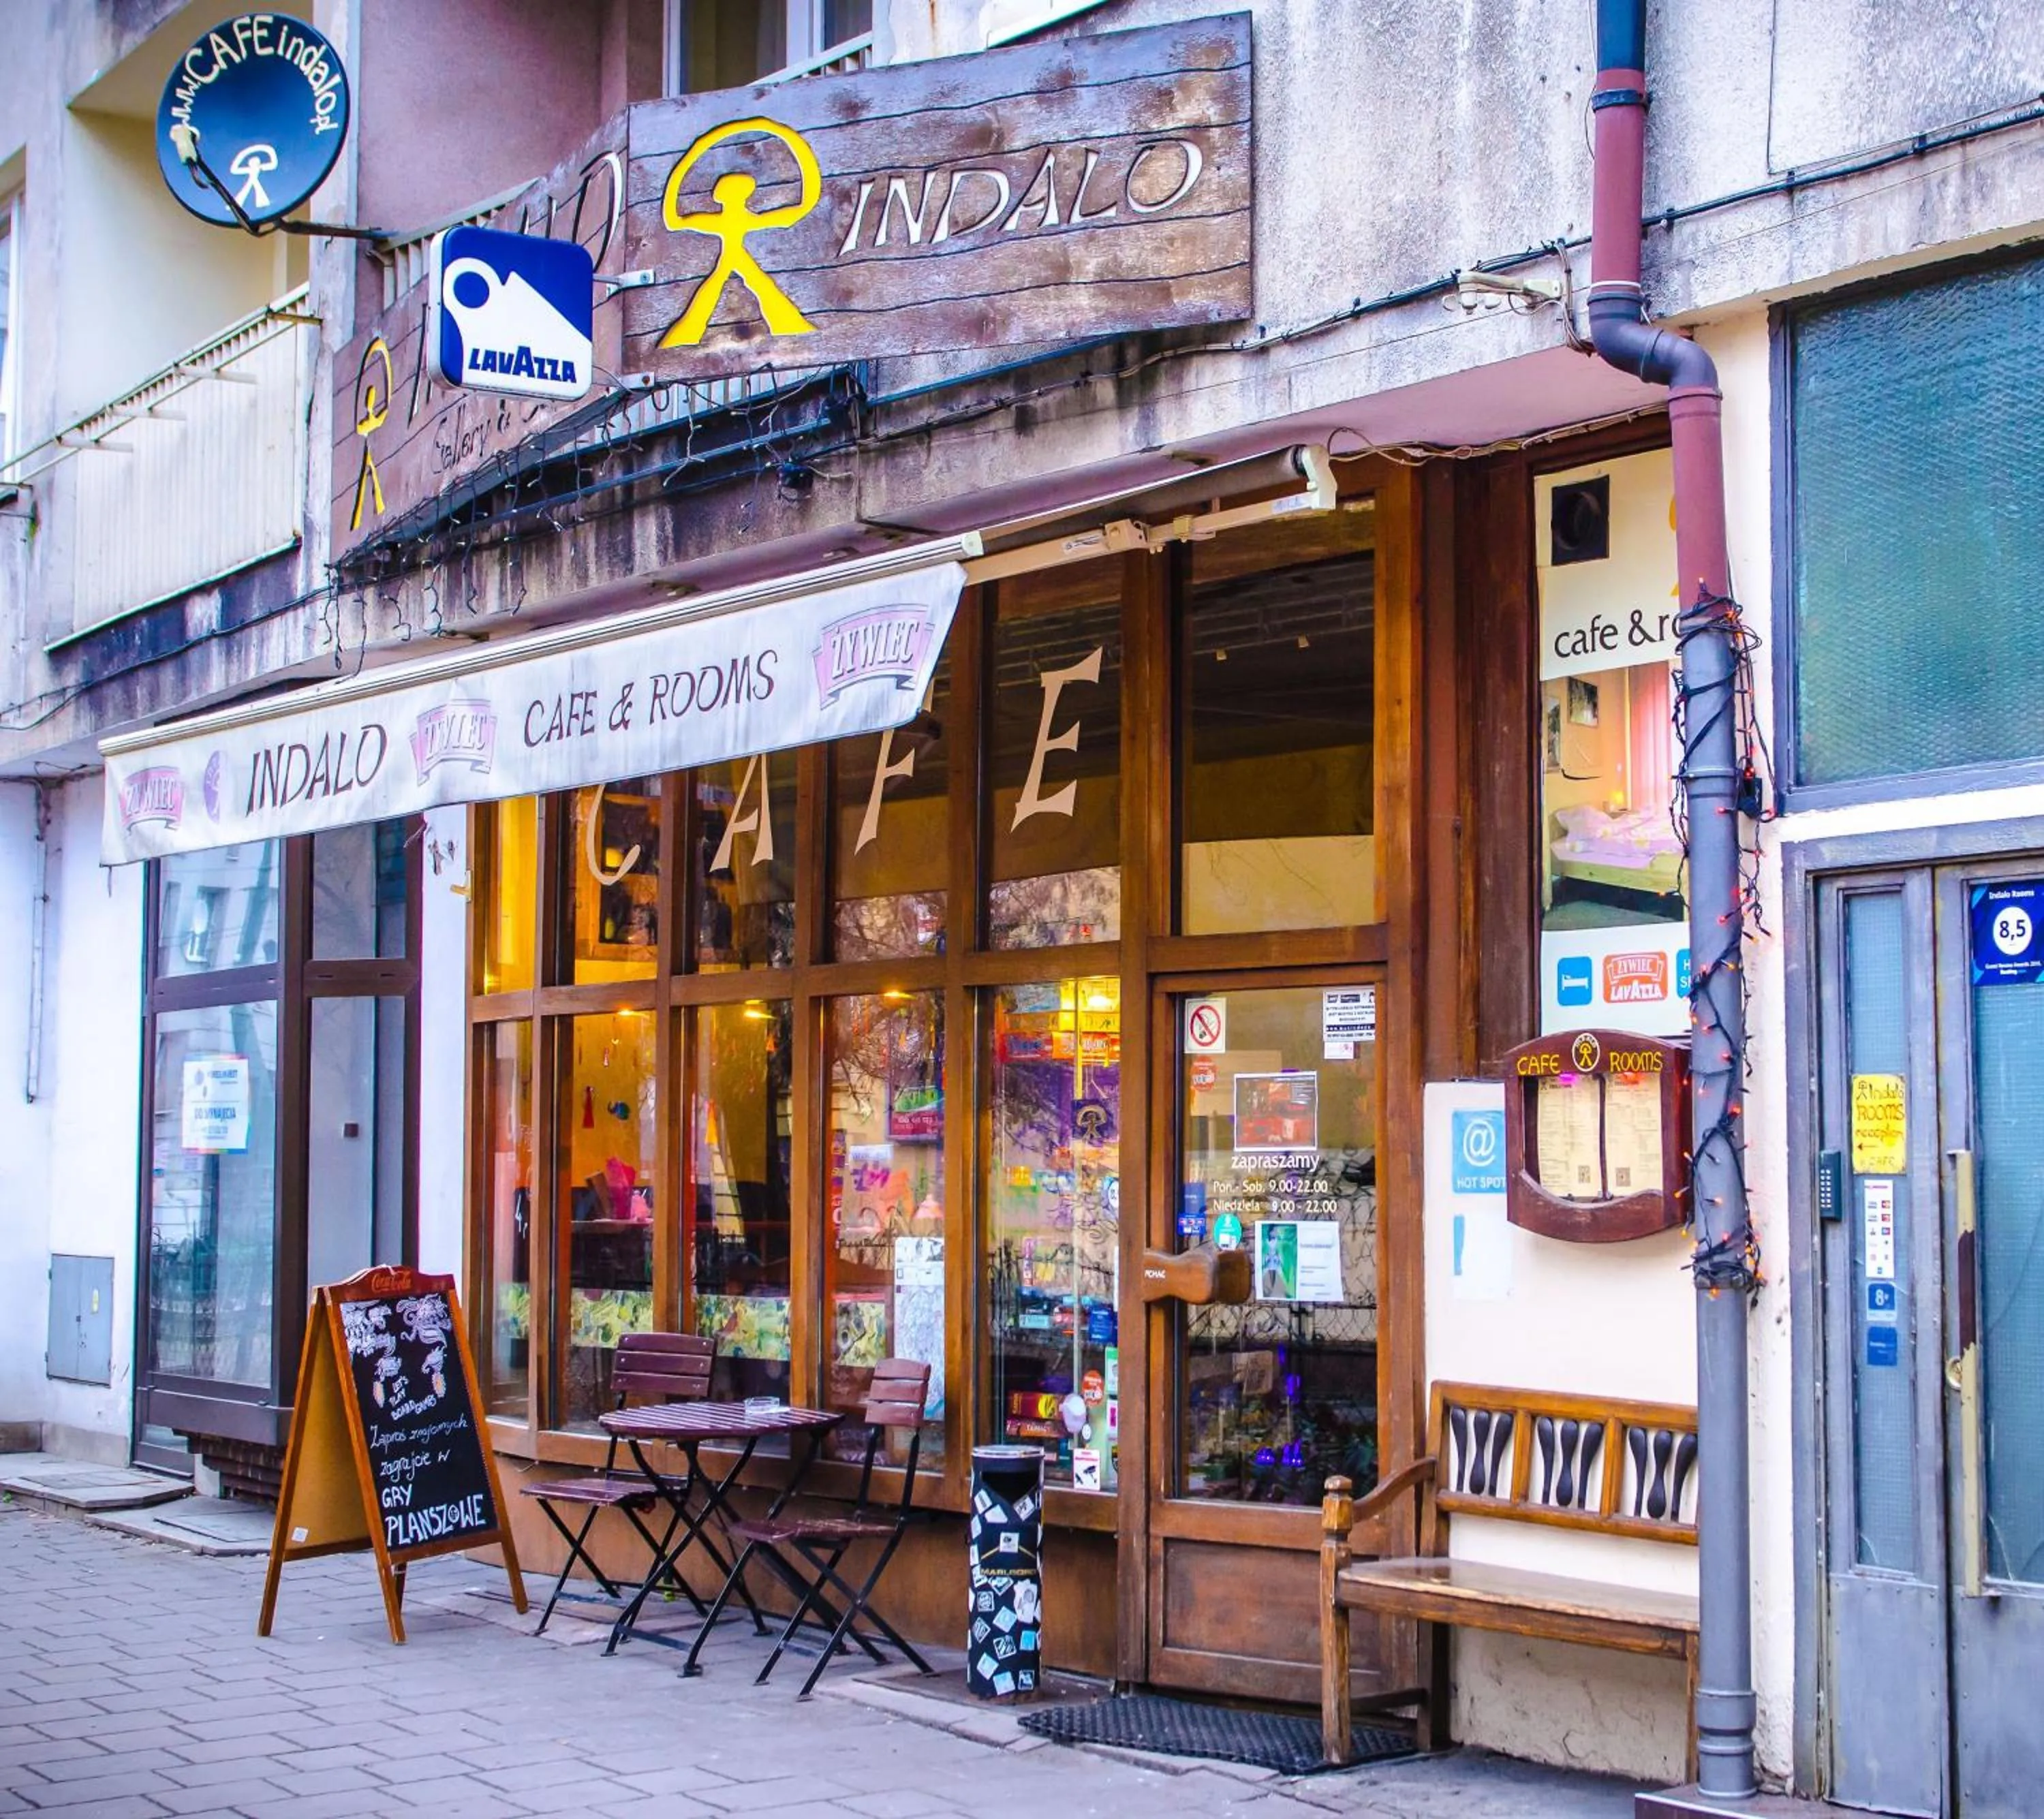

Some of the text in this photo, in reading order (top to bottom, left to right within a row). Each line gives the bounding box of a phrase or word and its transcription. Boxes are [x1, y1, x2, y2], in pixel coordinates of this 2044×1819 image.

[837, 139, 1203, 257] INDALO
[468, 345, 577, 384] LAVAZZA
[431, 403, 491, 474] Gallery
[1554, 615, 1618, 658] cafe
[1628, 609, 1657, 646] &
[523, 649, 778, 747] CAFE & ROOMS
[245, 724, 388, 818] INDALO
[586, 646, 1103, 886] CAFE
[1999, 920, 2026, 940] 8,5
[1611, 980, 1663, 1000] LAVAZZA
[1517, 1051, 1663, 1075] CAFE ROOMS
[1857, 1104, 1904, 1121] ROOMS
[1231, 1154, 1320, 1172] zapraszamy
[1457, 1177, 1506, 1189] HOT SPOT
[1213, 1199, 1260, 1211] Niedziela
[1305, 1200, 1337, 1213] 22.00
[382, 1483, 413, 1508] GRY
[385, 1493, 486, 1547] PLANSZOWE
